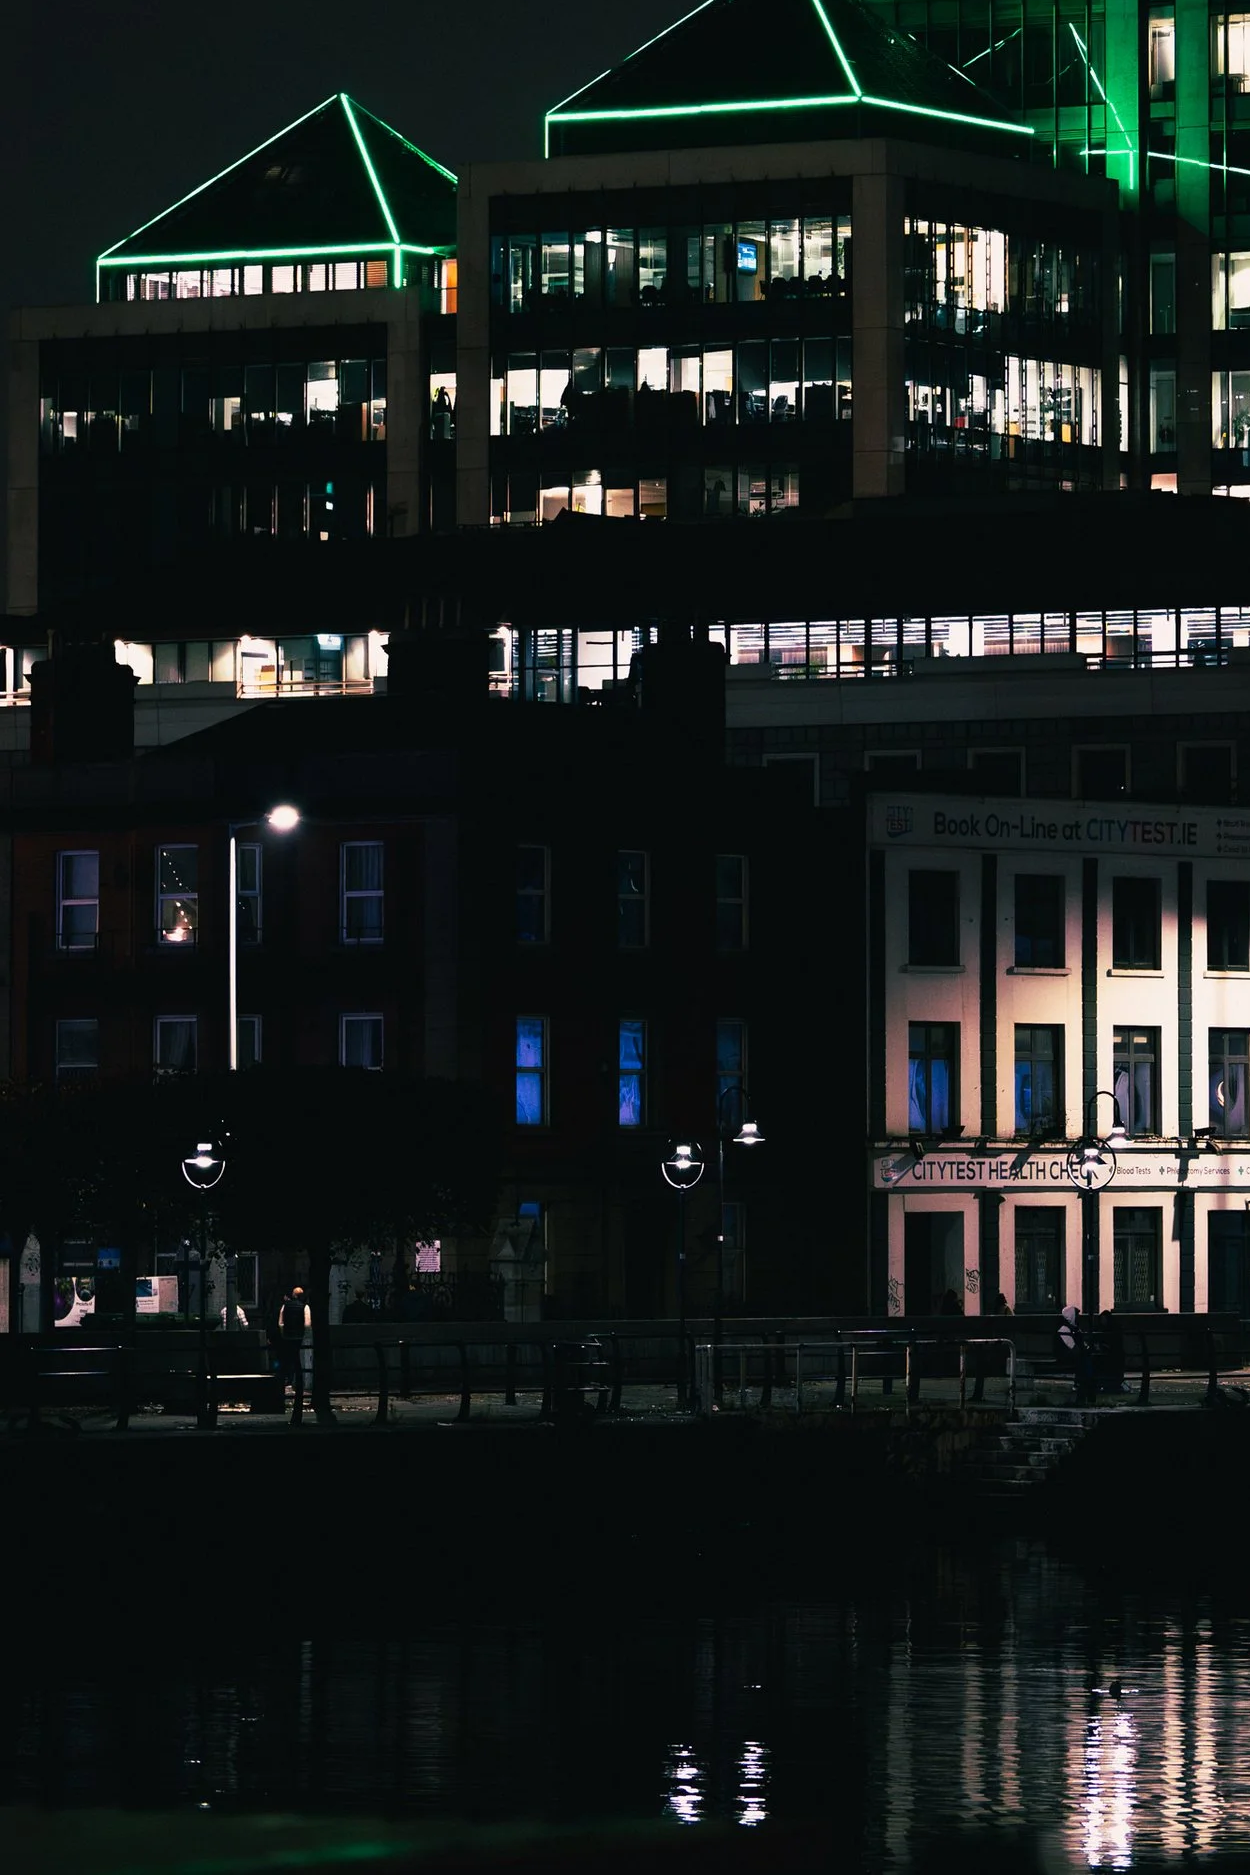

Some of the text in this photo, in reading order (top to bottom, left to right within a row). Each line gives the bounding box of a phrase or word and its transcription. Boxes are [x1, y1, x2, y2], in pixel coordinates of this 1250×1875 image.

[934, 811, 982, 836] Book
[985, 813, 1058, 840] On-Line
[1062, 819, 1081, 840] at
[1086, 817, 1198, 845] CITYTEST.IE
[912, 1161, 985, 1181] CITYTEST
[989, 1161, 1046, 1181] HEALTH
[1117, 1167, 1151, 1175] Blood Tests
[1204, 1166, 1230, 1175] Services
